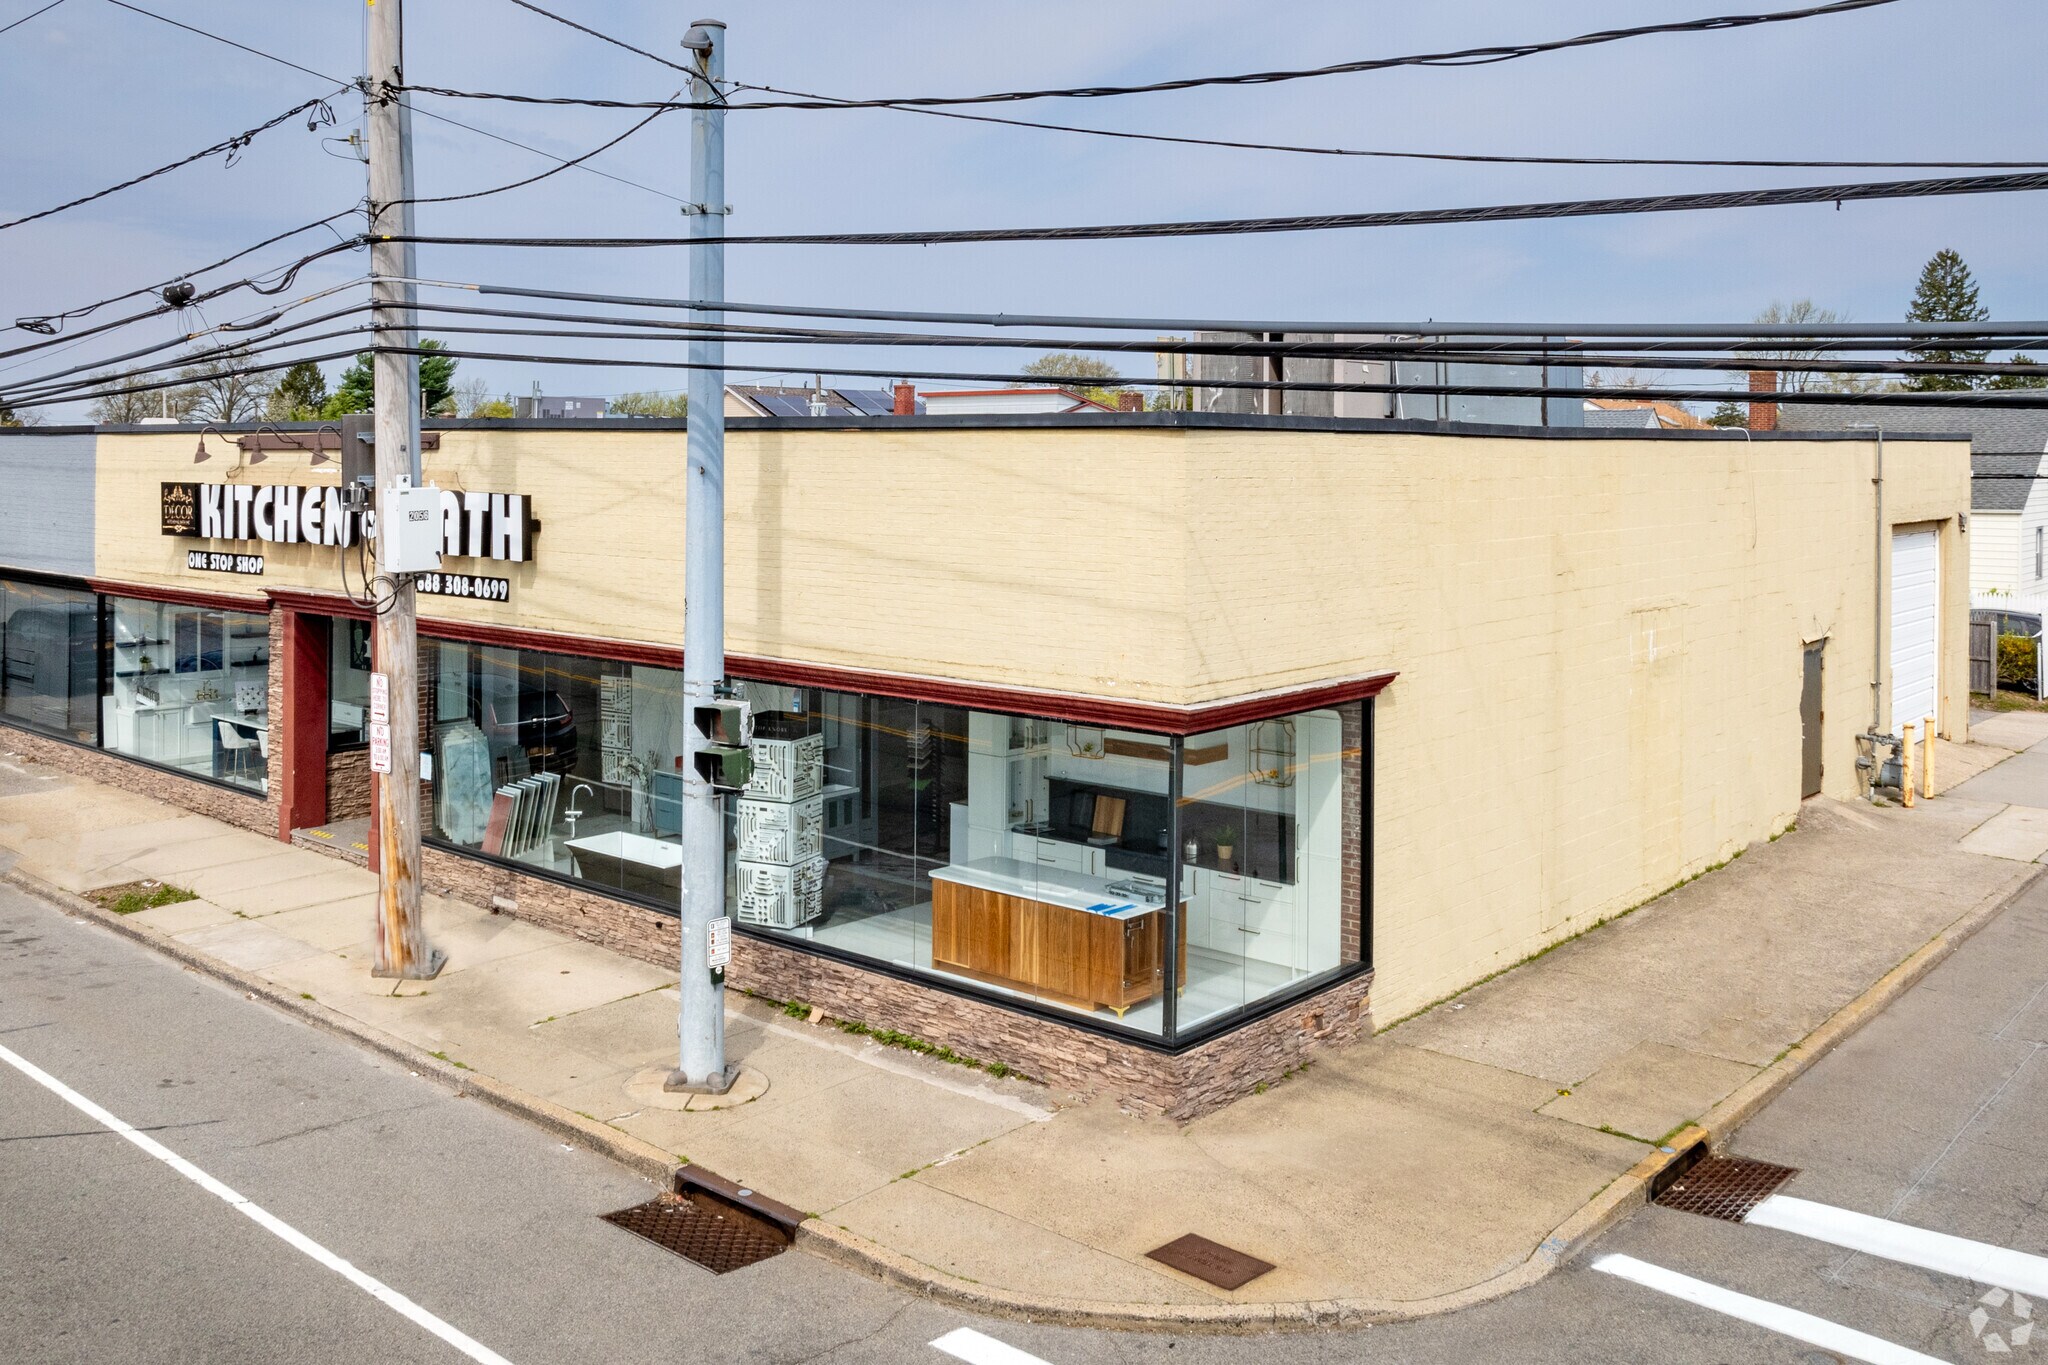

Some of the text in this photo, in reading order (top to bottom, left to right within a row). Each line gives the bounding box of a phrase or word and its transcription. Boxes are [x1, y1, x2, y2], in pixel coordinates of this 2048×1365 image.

[201, 484, 351, 548] KITCHEN
[440, 490, 523, 562] ATH
[188, 552, 264, 573] ONE STOP SHOP
[445, 575, 508, 600] 308-0699
[372, 736, 389, 747] PARKING
[376, 726, 384, 736] NO
